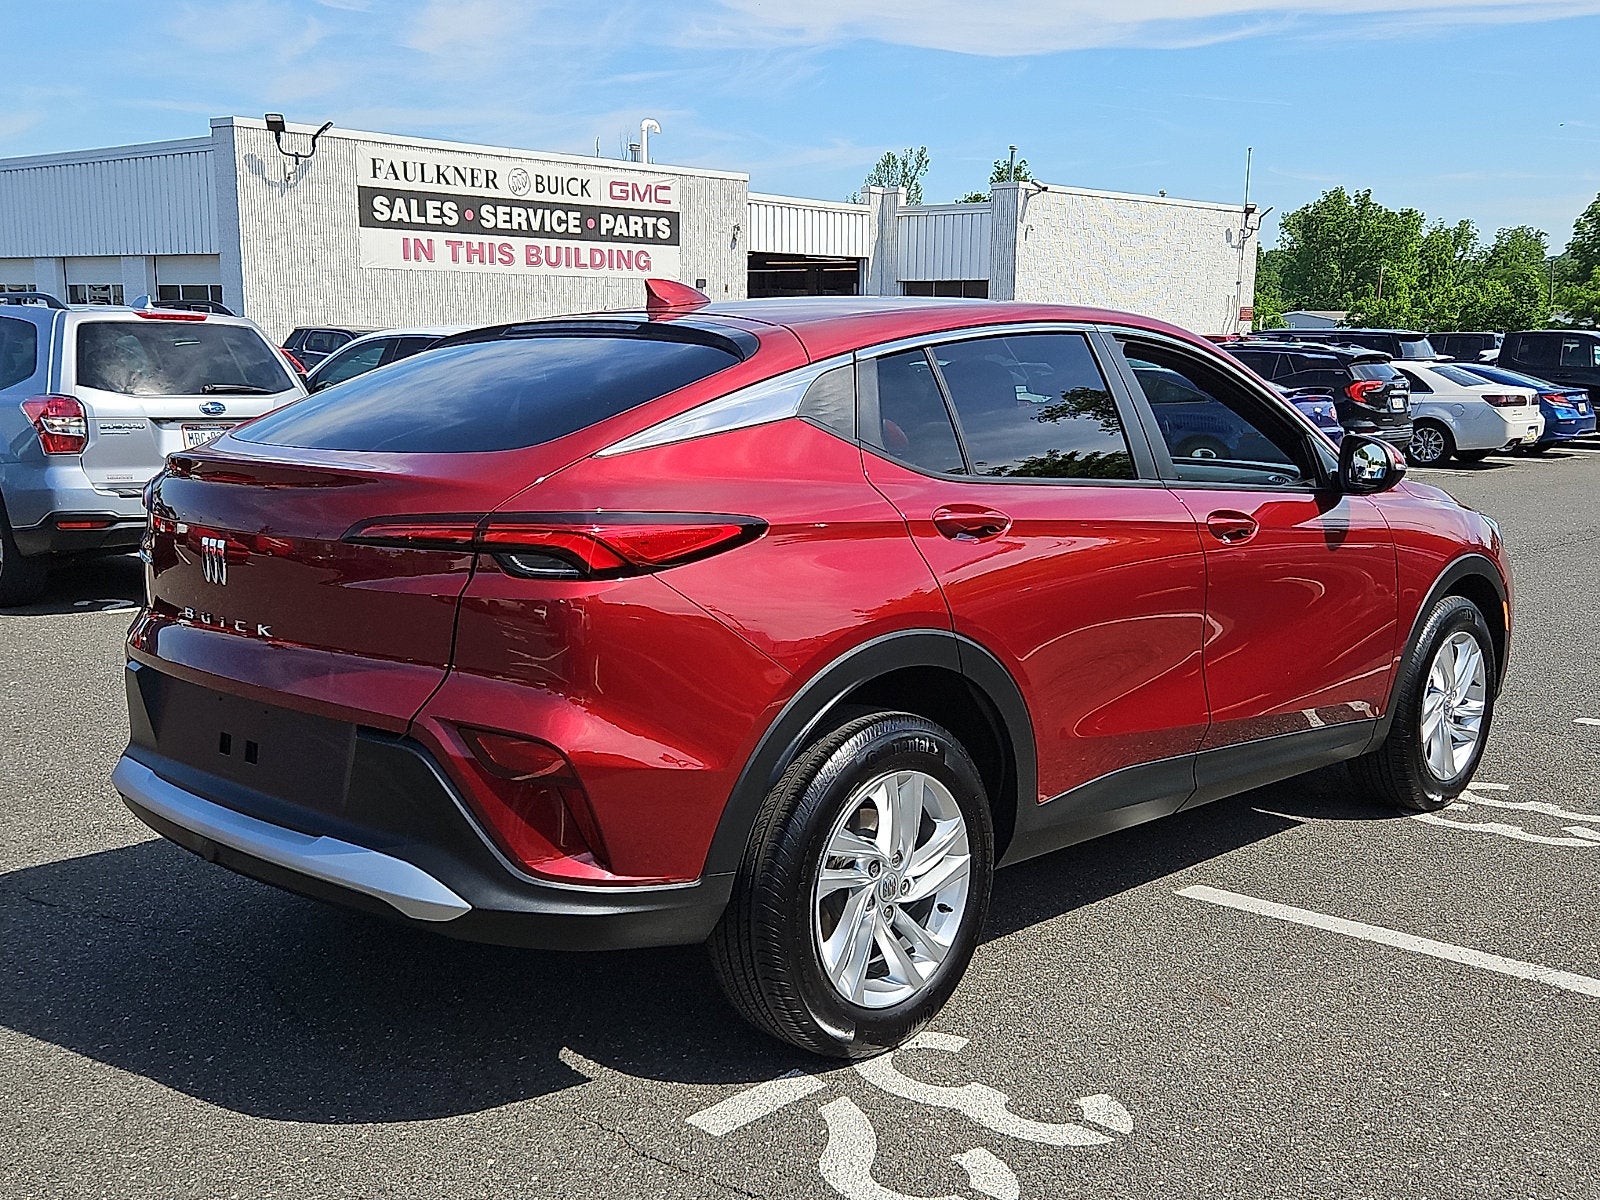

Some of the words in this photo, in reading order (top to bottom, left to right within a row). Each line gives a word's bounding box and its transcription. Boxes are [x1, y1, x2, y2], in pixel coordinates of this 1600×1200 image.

[369, 157, 500, 190] FAULKNER
[535, 174, 591, 197] BUICK
[609, 181, 672, 204] GMC
[372, 195, 460, 226] SALES
[480, 204, 582, 234] SERVICE
[599, 213, 672, 240] PARTS
[402, 237, 435, 262] IN
[445, 240, 515, 266] THIS
[525, 244, 652, 272] BUILDING
